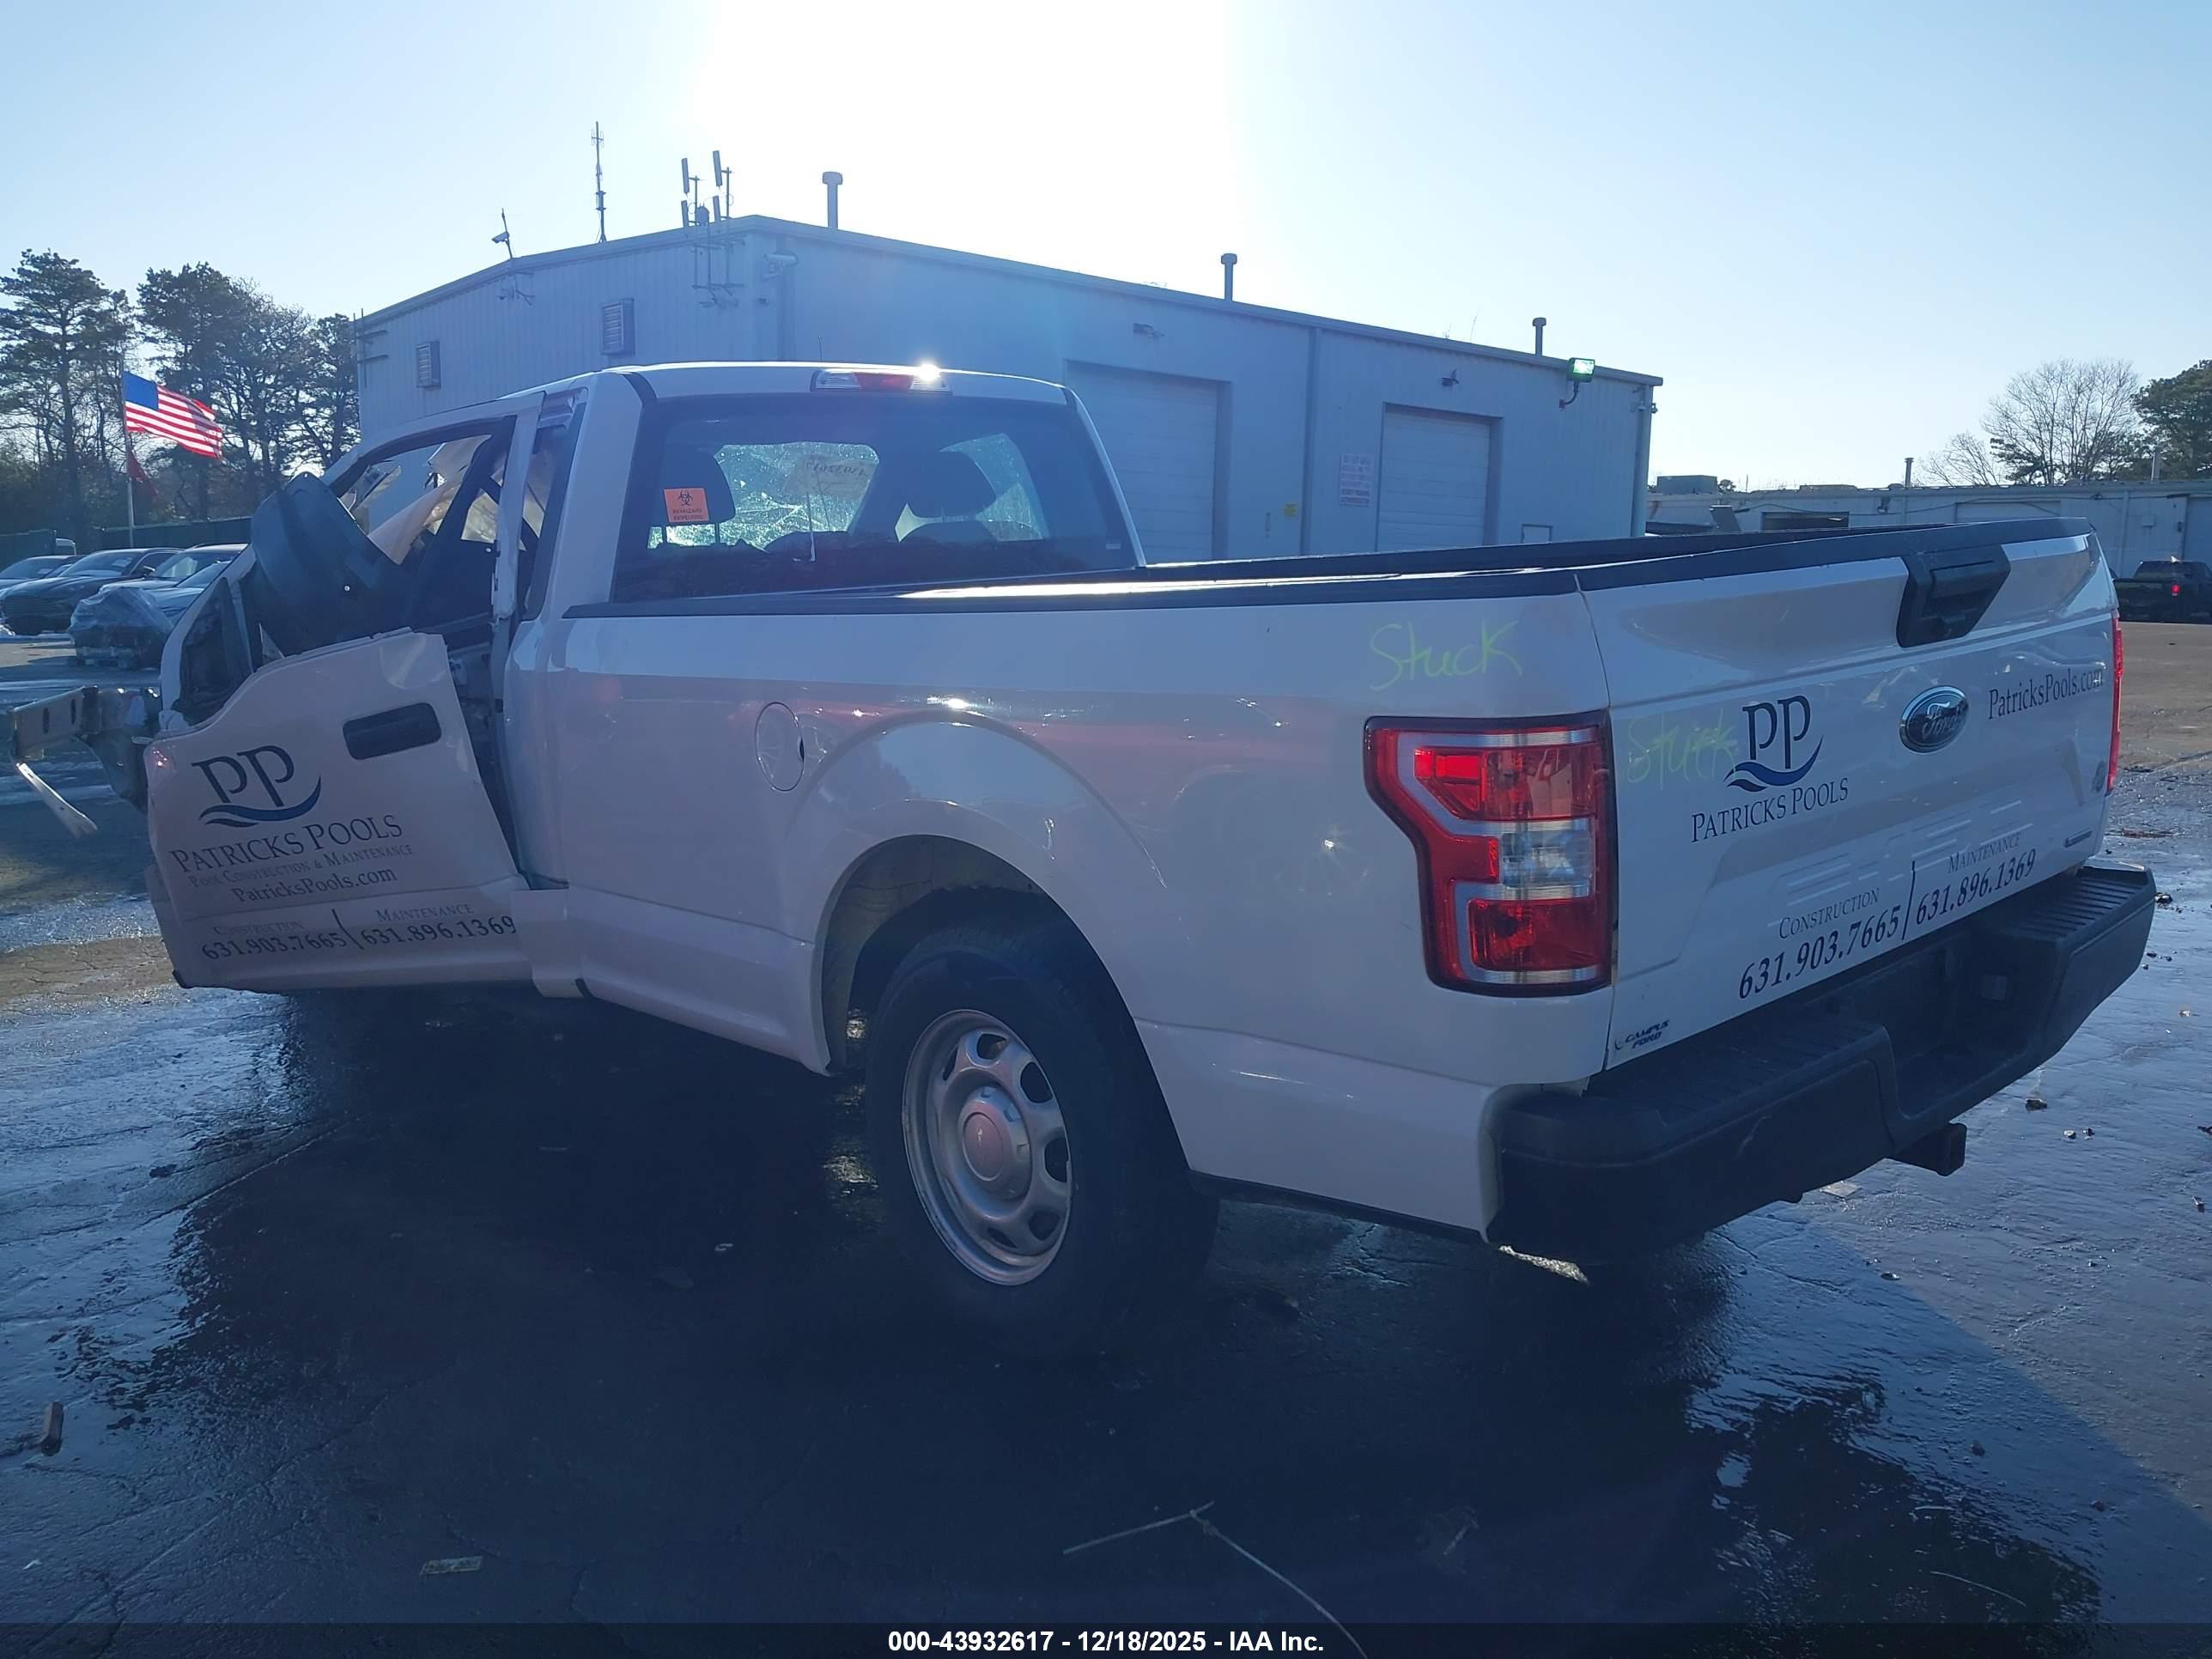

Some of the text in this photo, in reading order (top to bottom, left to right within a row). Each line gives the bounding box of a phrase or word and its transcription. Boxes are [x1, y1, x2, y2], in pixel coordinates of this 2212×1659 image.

[1988, 667, 2103, 720] PatricksPools.com
[1742, 695, 1811, 769] PP
[191, 744, 295, 807] PP
[1691, 777, 1849, 843] PATRICKS POOLS
[169, 815, 403, 872] PATRICKS POOLS
[222, 861, 311, 884] CONSTRUCTION
[323, 844, 414, 866] MAINTENANCE
[1948, 831, 2021, 874] MAINTENANCE
[231, 868, 398, 902] PatricksPools.com
[1916, 848, 2037, 926] 631.896.1369
[361, 915, 518, 946] 631.896.1369
[375, 902, 474, 923] MAINTENANCE
[1778, 887, 1881, 940] CONSTRUCTION
[202, 933, 347, 960] 631.903.7665
[1739, 904, 1902, 1000] 631.903.7665
